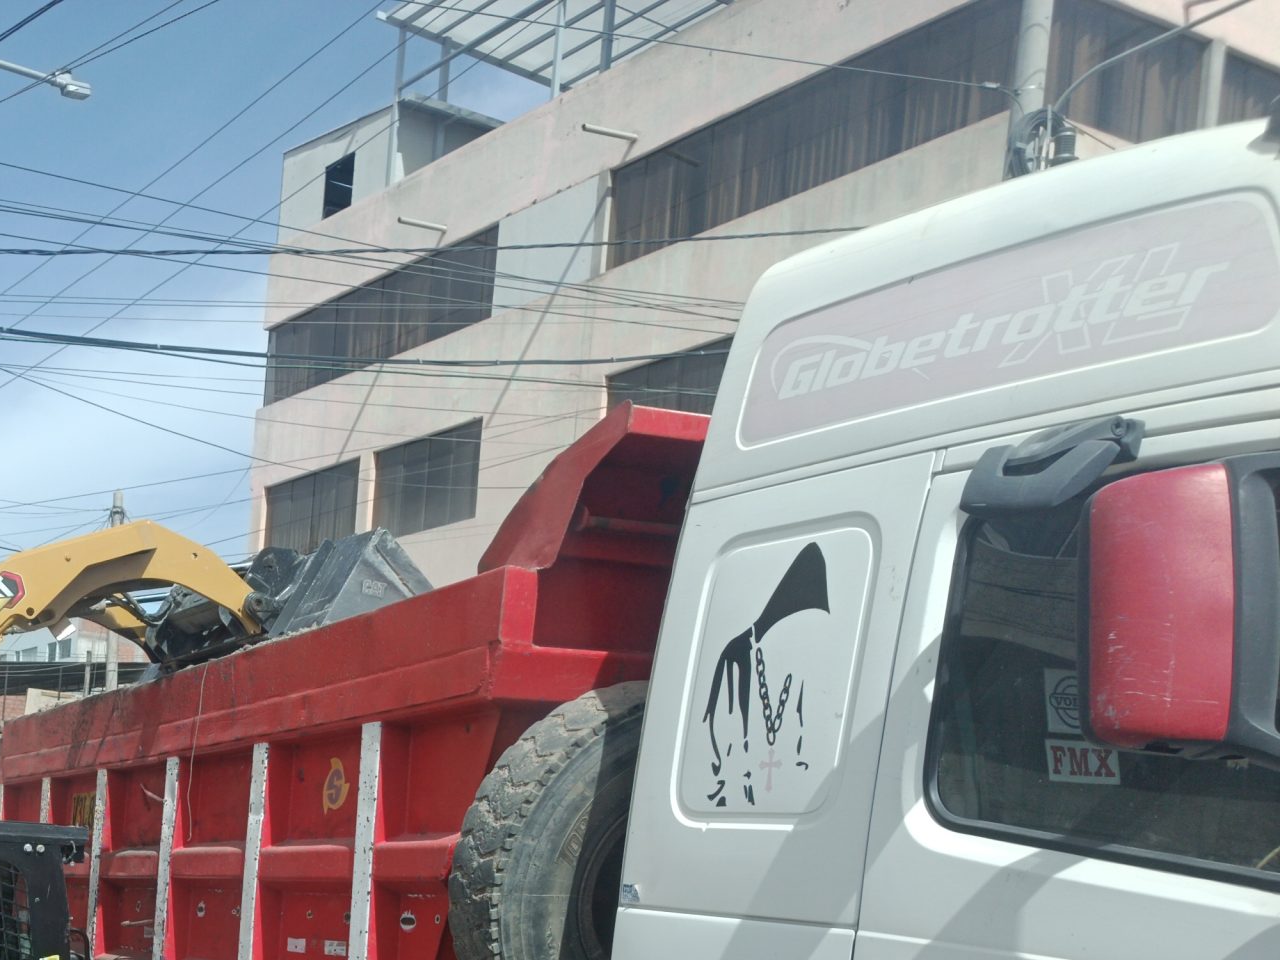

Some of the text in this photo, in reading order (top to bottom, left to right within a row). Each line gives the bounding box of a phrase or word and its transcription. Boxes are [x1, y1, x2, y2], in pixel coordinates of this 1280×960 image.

[777, 261, 1230, 400] Globetrotter
[361, 579, 388, 600] CAT
[1050, 745, 1116, 778] FMX
